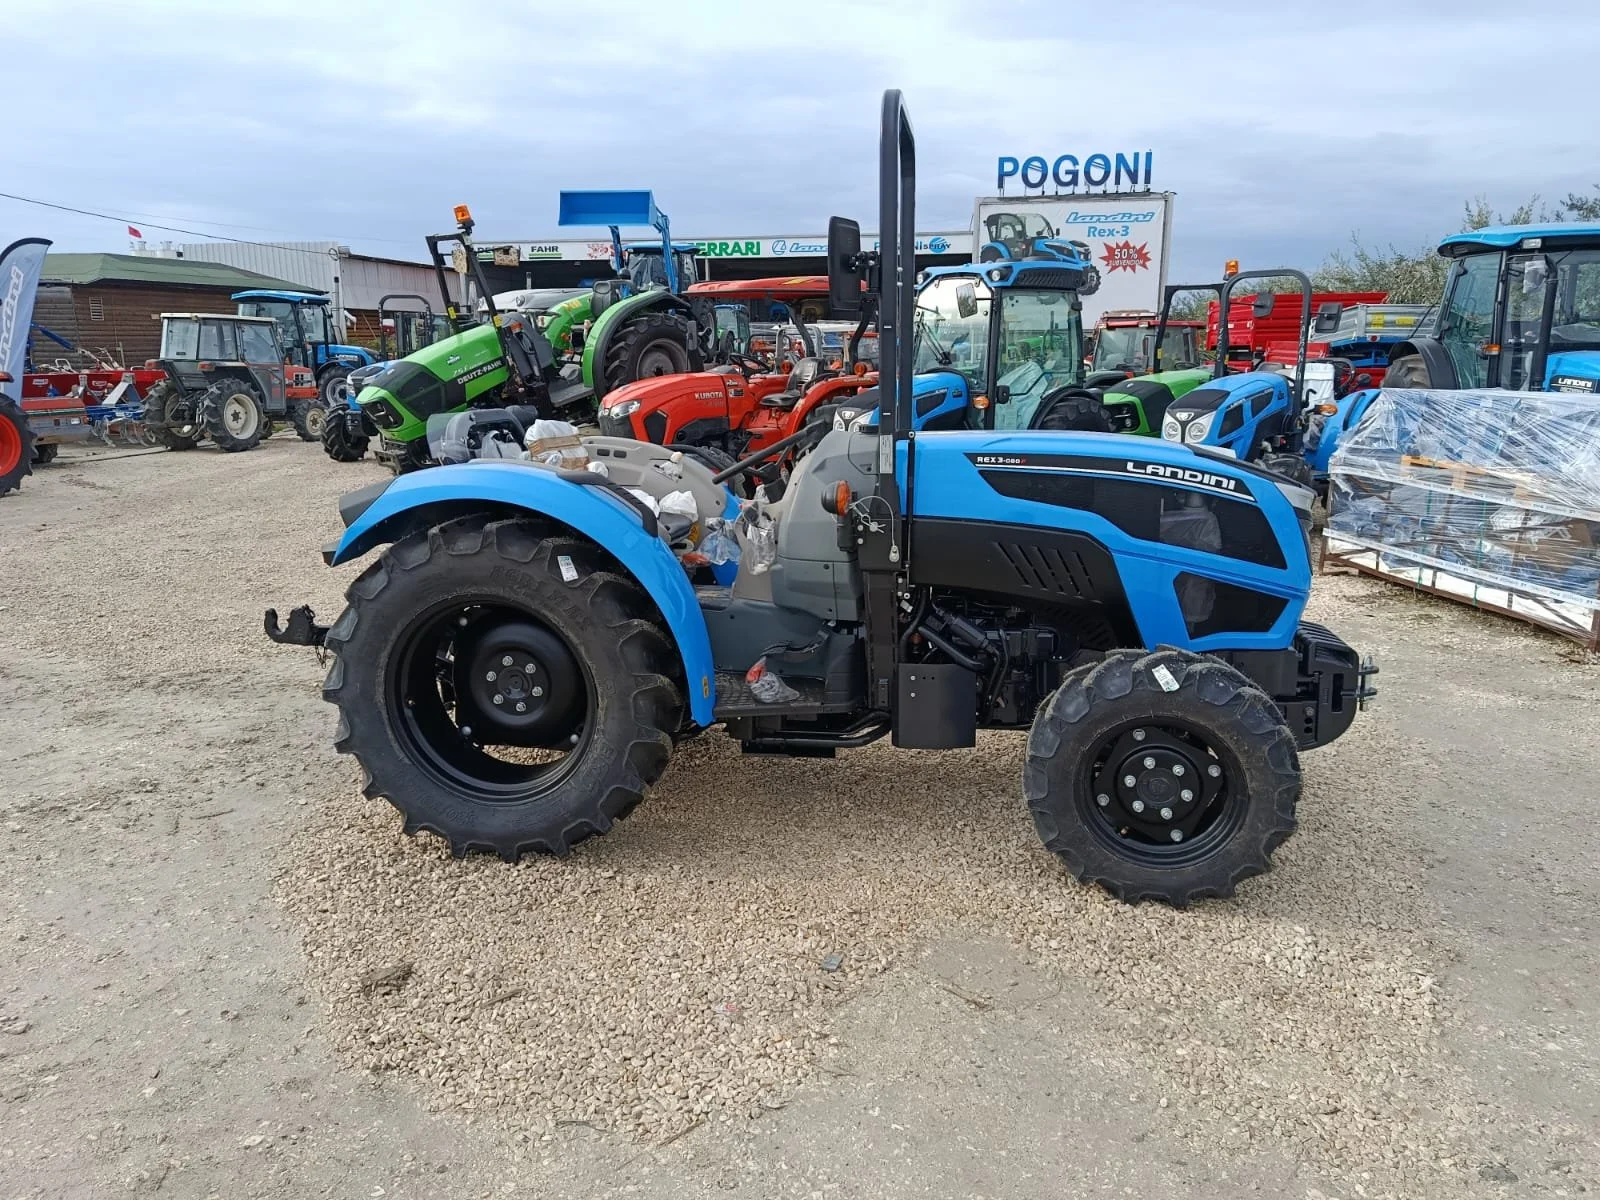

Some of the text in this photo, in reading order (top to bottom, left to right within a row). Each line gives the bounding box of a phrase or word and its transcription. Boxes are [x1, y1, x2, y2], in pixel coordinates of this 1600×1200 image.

[998, 152, 1152, 189] POGONI
[1066, 211, 1155, 224] Landini
[1087, 225, 1130, 238] Rex-3
[531, 245, 559, 253] FAHR
[1114, 248, 1138, 260] 50%
[694, 391, 723, 400] KUBOTA
[1126, 461, 1236, 490] LANDINI
